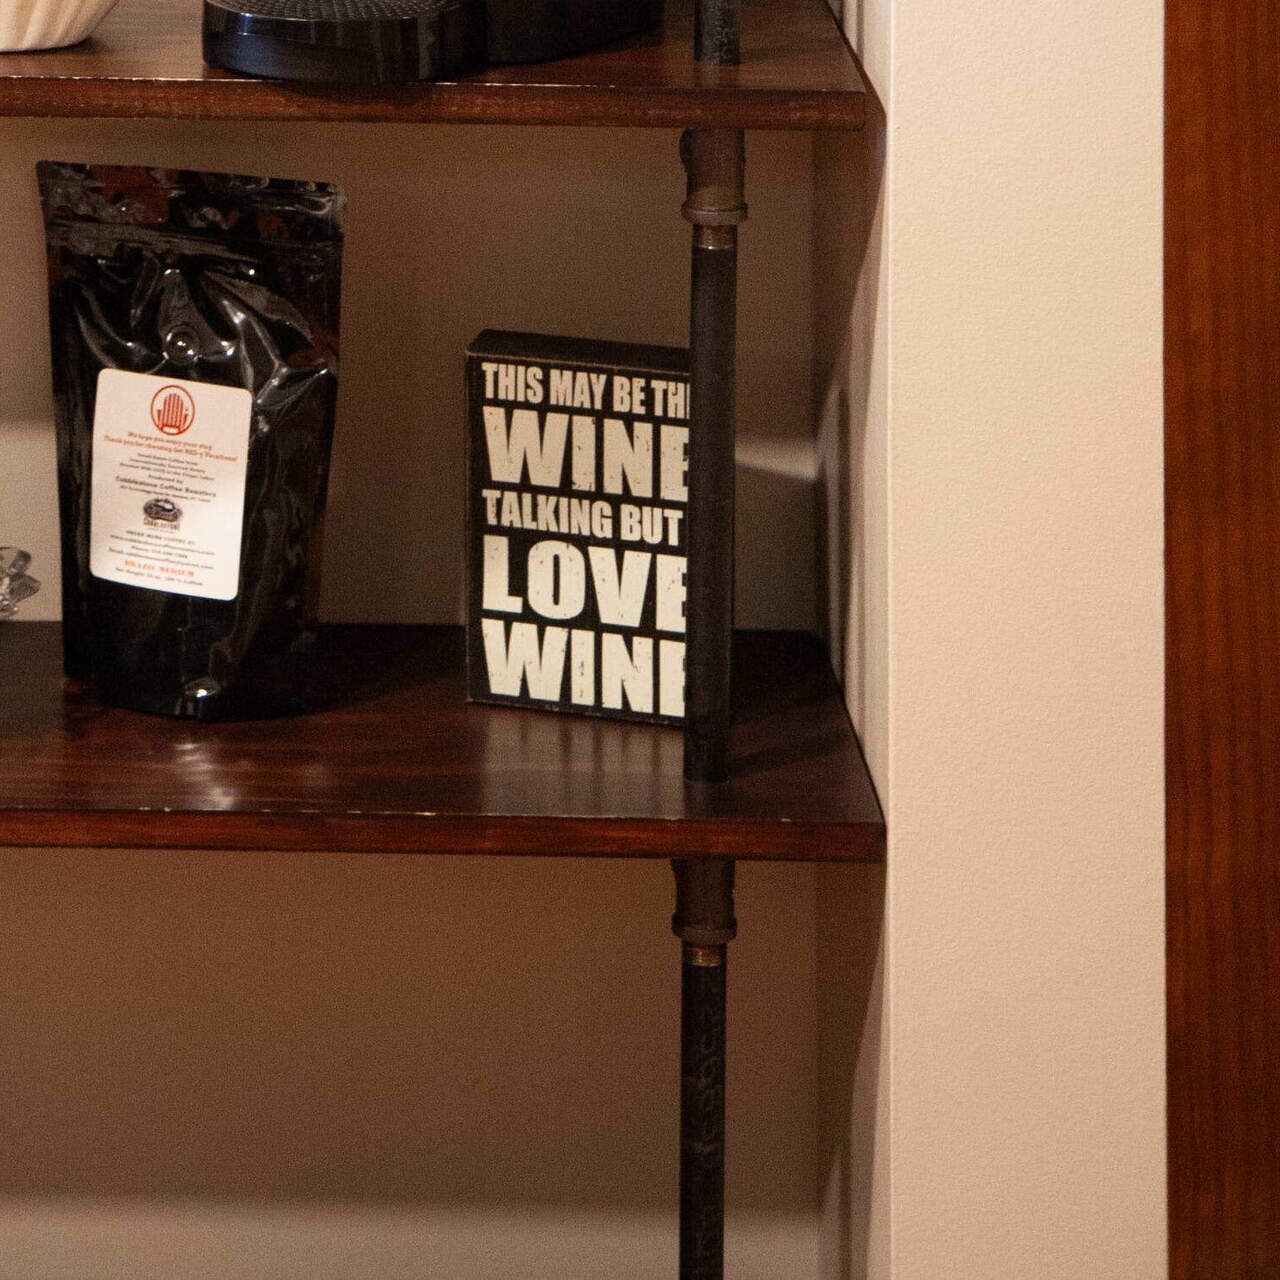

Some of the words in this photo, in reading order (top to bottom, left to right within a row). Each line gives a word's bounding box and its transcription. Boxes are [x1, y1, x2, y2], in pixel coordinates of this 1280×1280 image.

[480, 361, 544, 405] THIS
[549, 368, 608, 411] MAY
[612, 375, 647, 416] BE
[650, 379, 691, 421] TH
[481, 405, 690, 503] WINE
[481, 488, 613, 540] TALKING
[619, 503, 684, 547] BUT
[481, 534, 689, 634] LOVE
[480, 617, 687, 719] WINE
